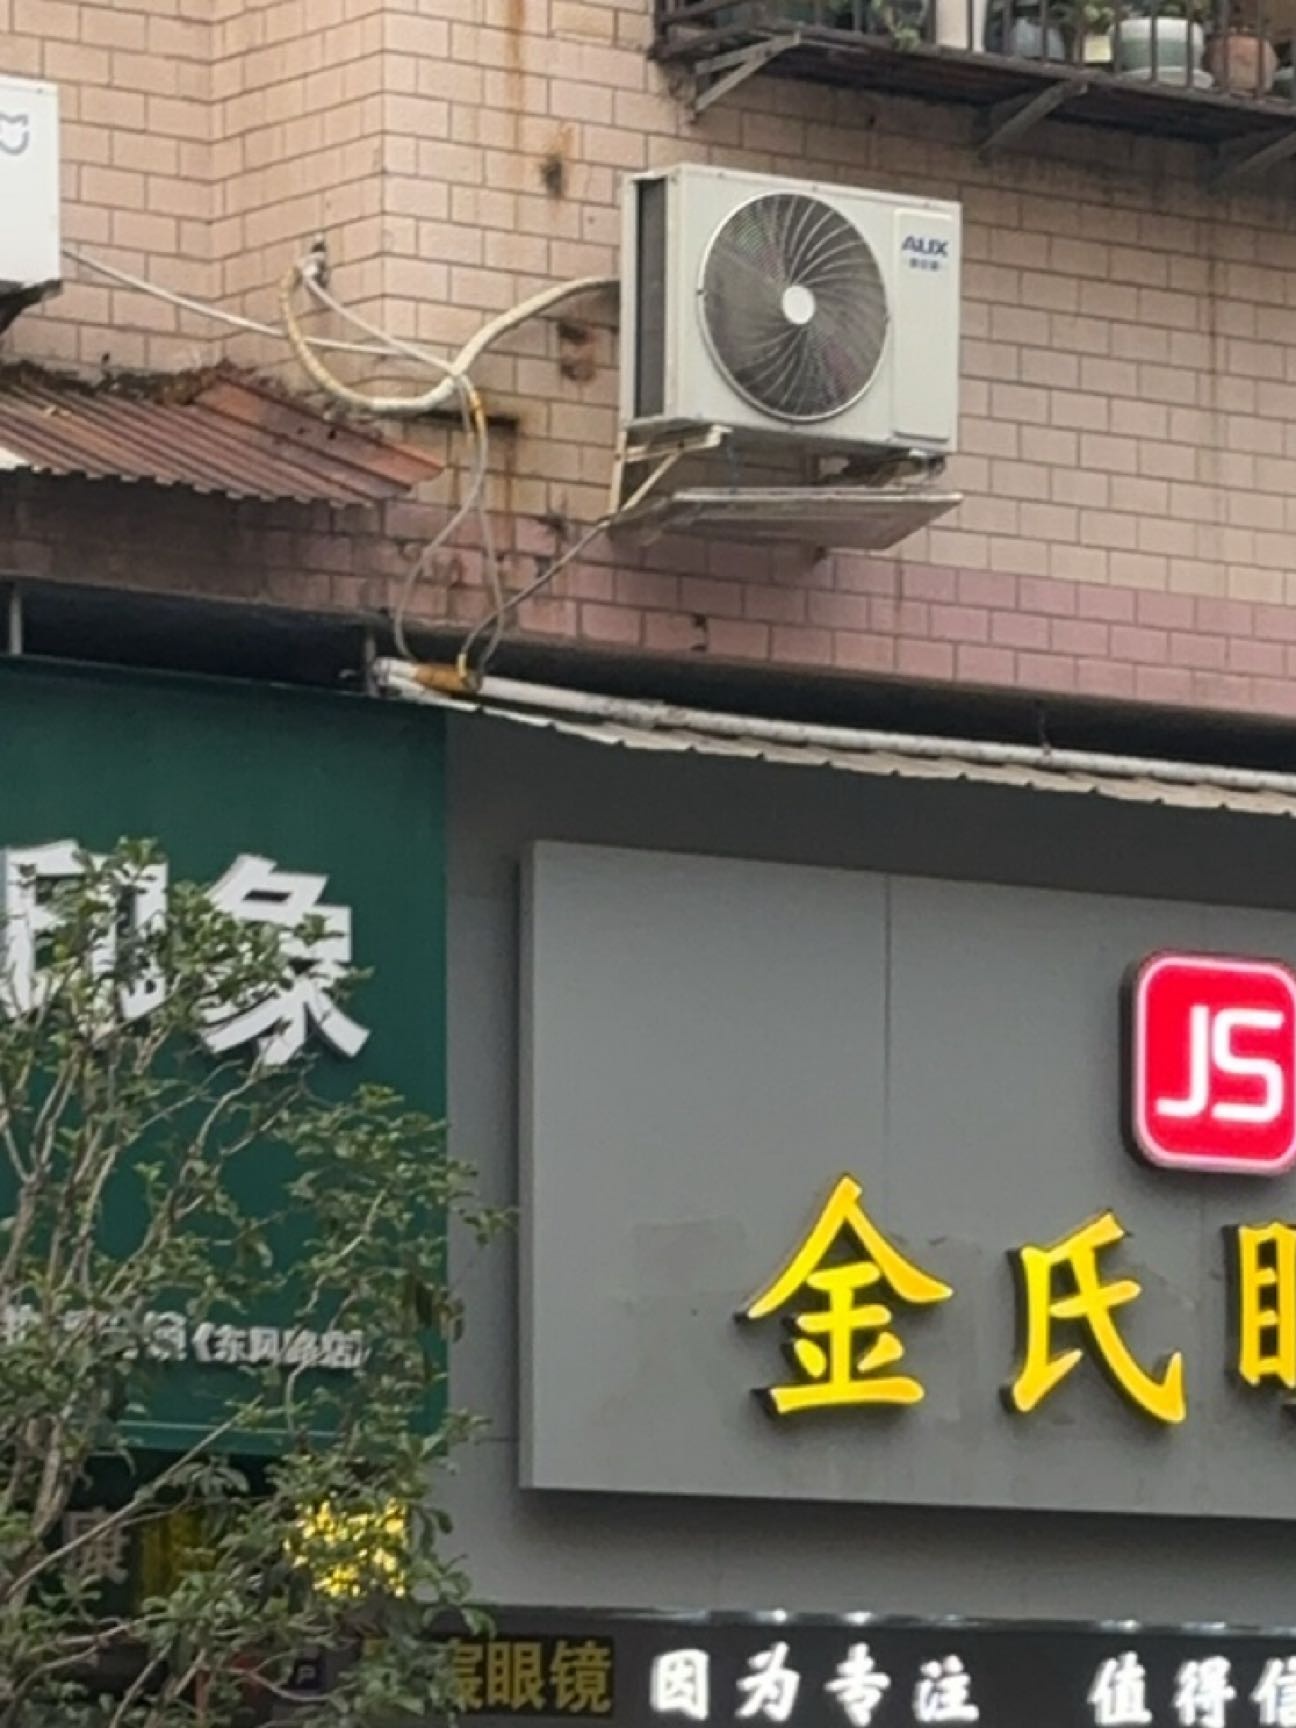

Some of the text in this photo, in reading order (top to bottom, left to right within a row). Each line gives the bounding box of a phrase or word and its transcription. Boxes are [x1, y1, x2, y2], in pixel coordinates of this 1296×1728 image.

[1156, 1003, 1286, 1123] JS
[647, 1640, 983, 1728] 因为专注
